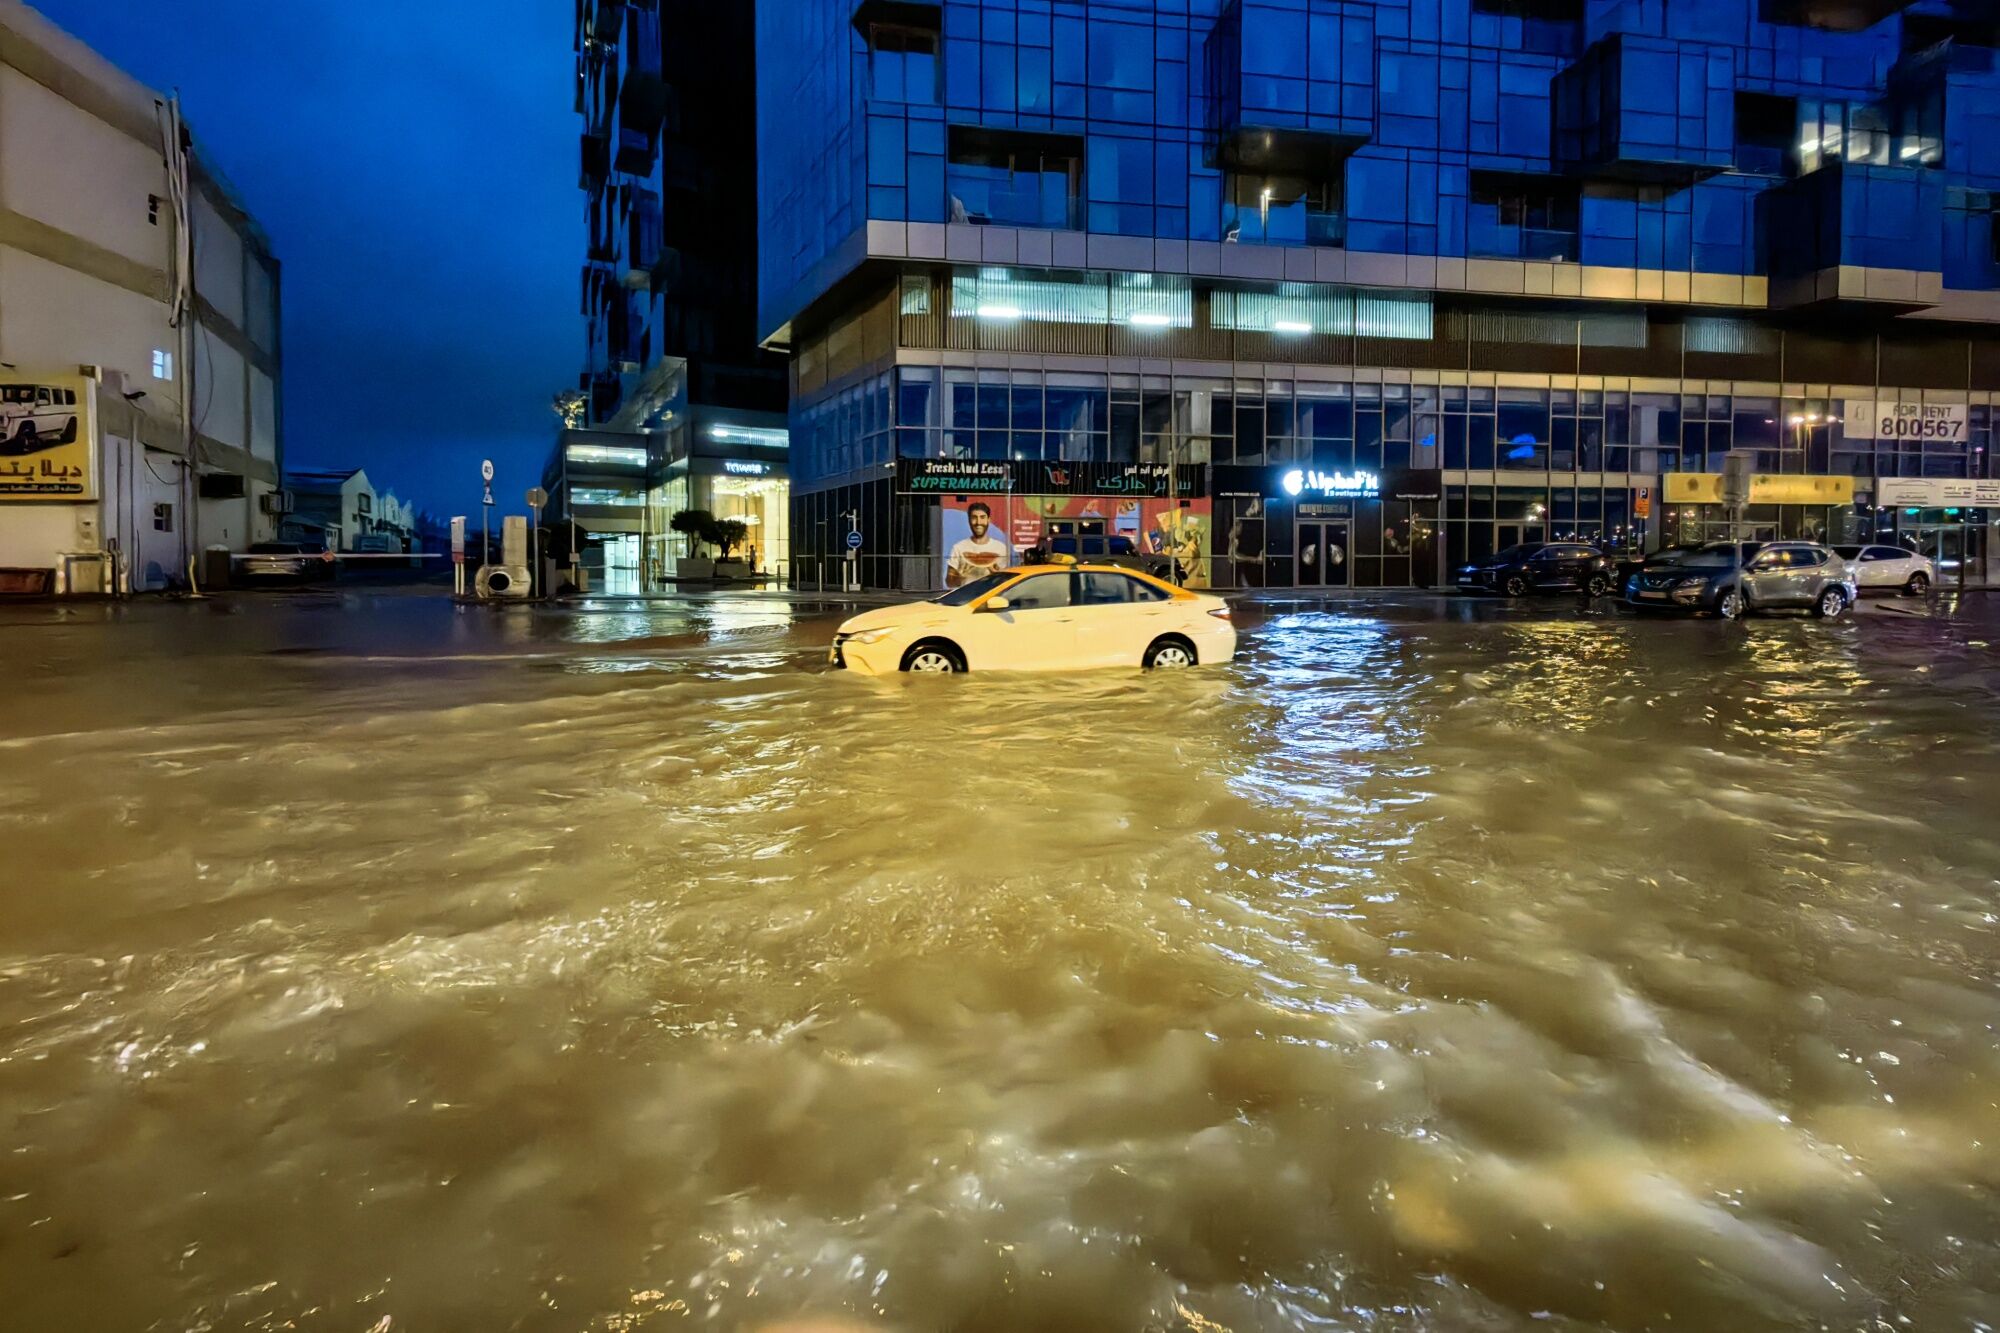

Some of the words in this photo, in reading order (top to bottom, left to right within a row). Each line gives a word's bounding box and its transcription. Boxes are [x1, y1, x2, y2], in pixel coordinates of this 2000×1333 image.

[1893, 405, 1917, 417] FOR
[1881, 417, 1963, 437] 800567
[925, 462, 954, 474] Fresh
[911, 477, 1016, 490] SUPERMARKET
